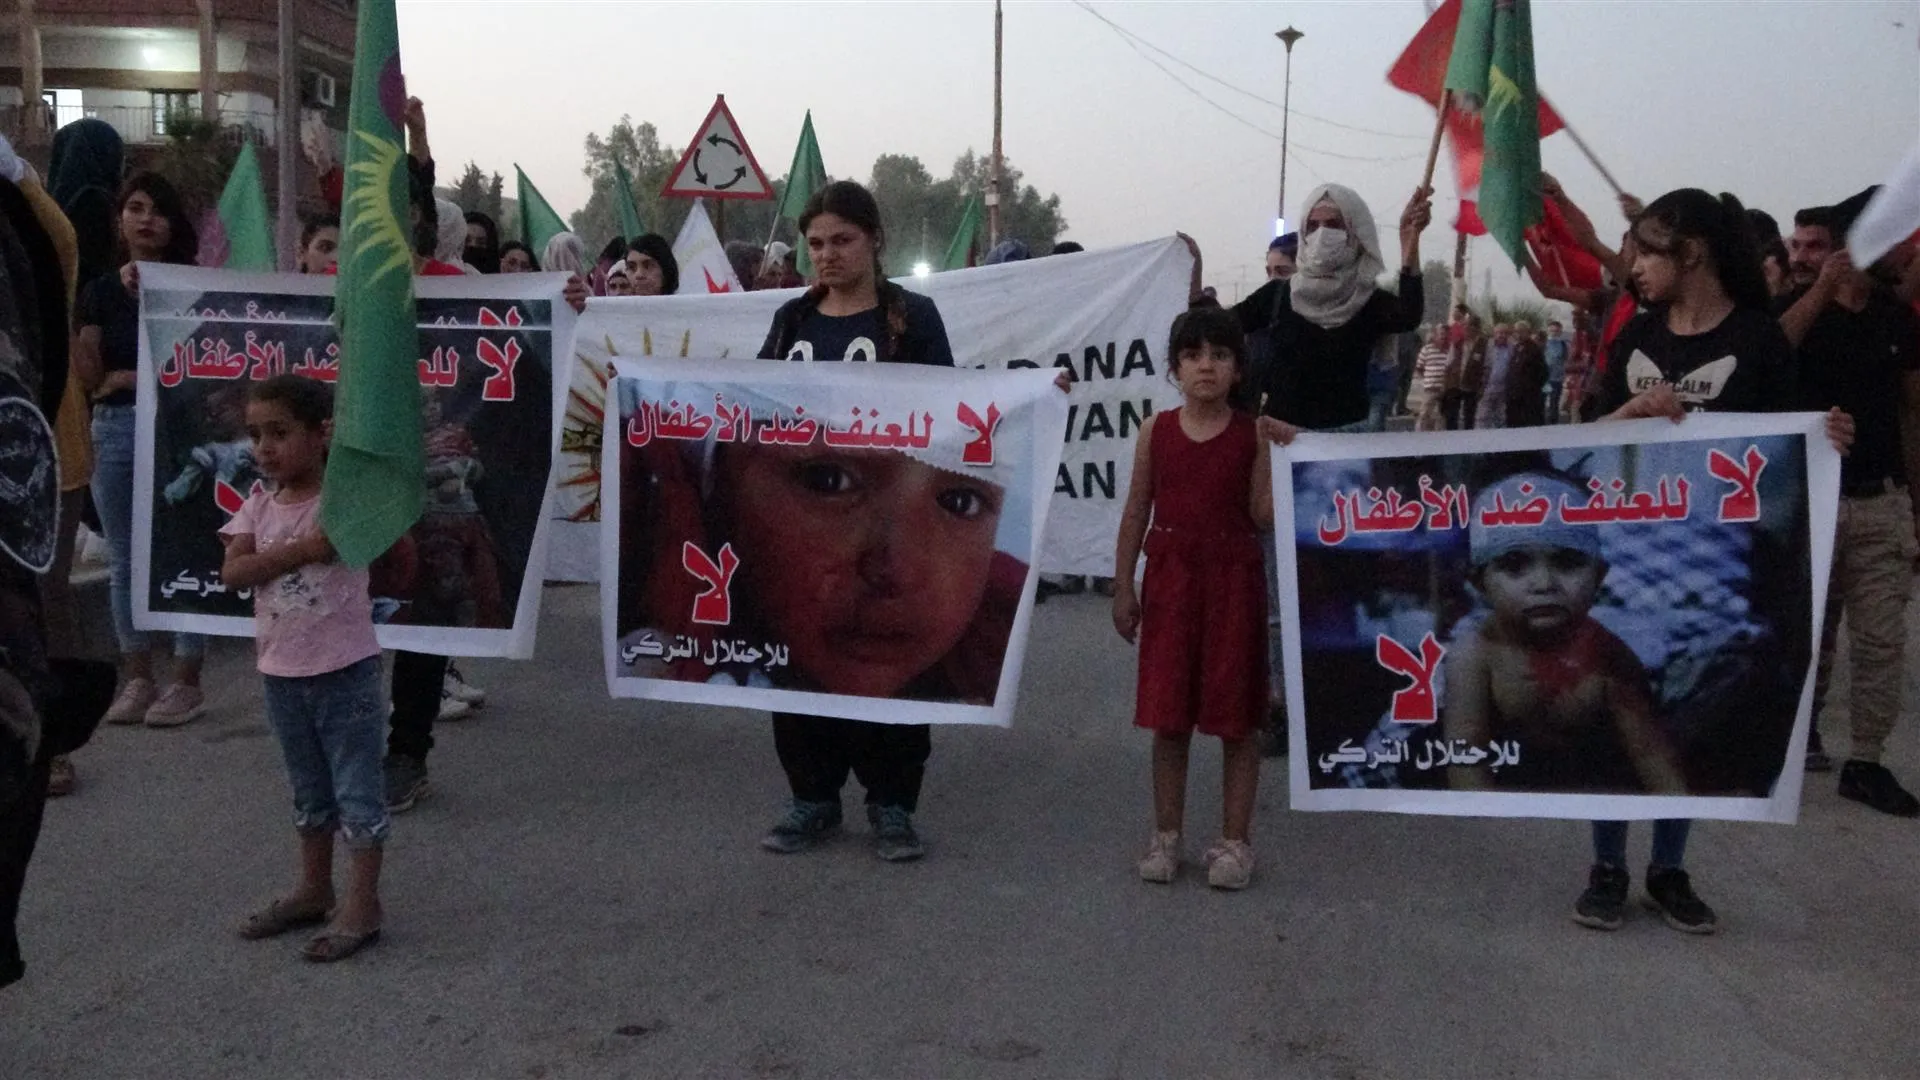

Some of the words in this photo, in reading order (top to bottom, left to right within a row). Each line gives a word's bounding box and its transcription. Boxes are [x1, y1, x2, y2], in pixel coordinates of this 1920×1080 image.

[477, 336, 522, 400] لا
[1672, 380, 1712, 395] CALM
[627, 392, 751, 447] الأطفال
[758, 404, 821, 447] ضد
[823, 406, 935, 449] للعنف
[956, 400, 1002, 467] لا
[1479, 480, 1551, 528] ضد
[1559, 474, 1692, 526] للعنف
[1706, 443, 1768, 523] لا
[1318, 474, 1469, 546] الأطفال
[682, 541, 740, 625] لا
[621, 633, 699, 666] التركي
[1376, 630, 1446, 724] لا
[1318, 738, 1410, 774] التركي
